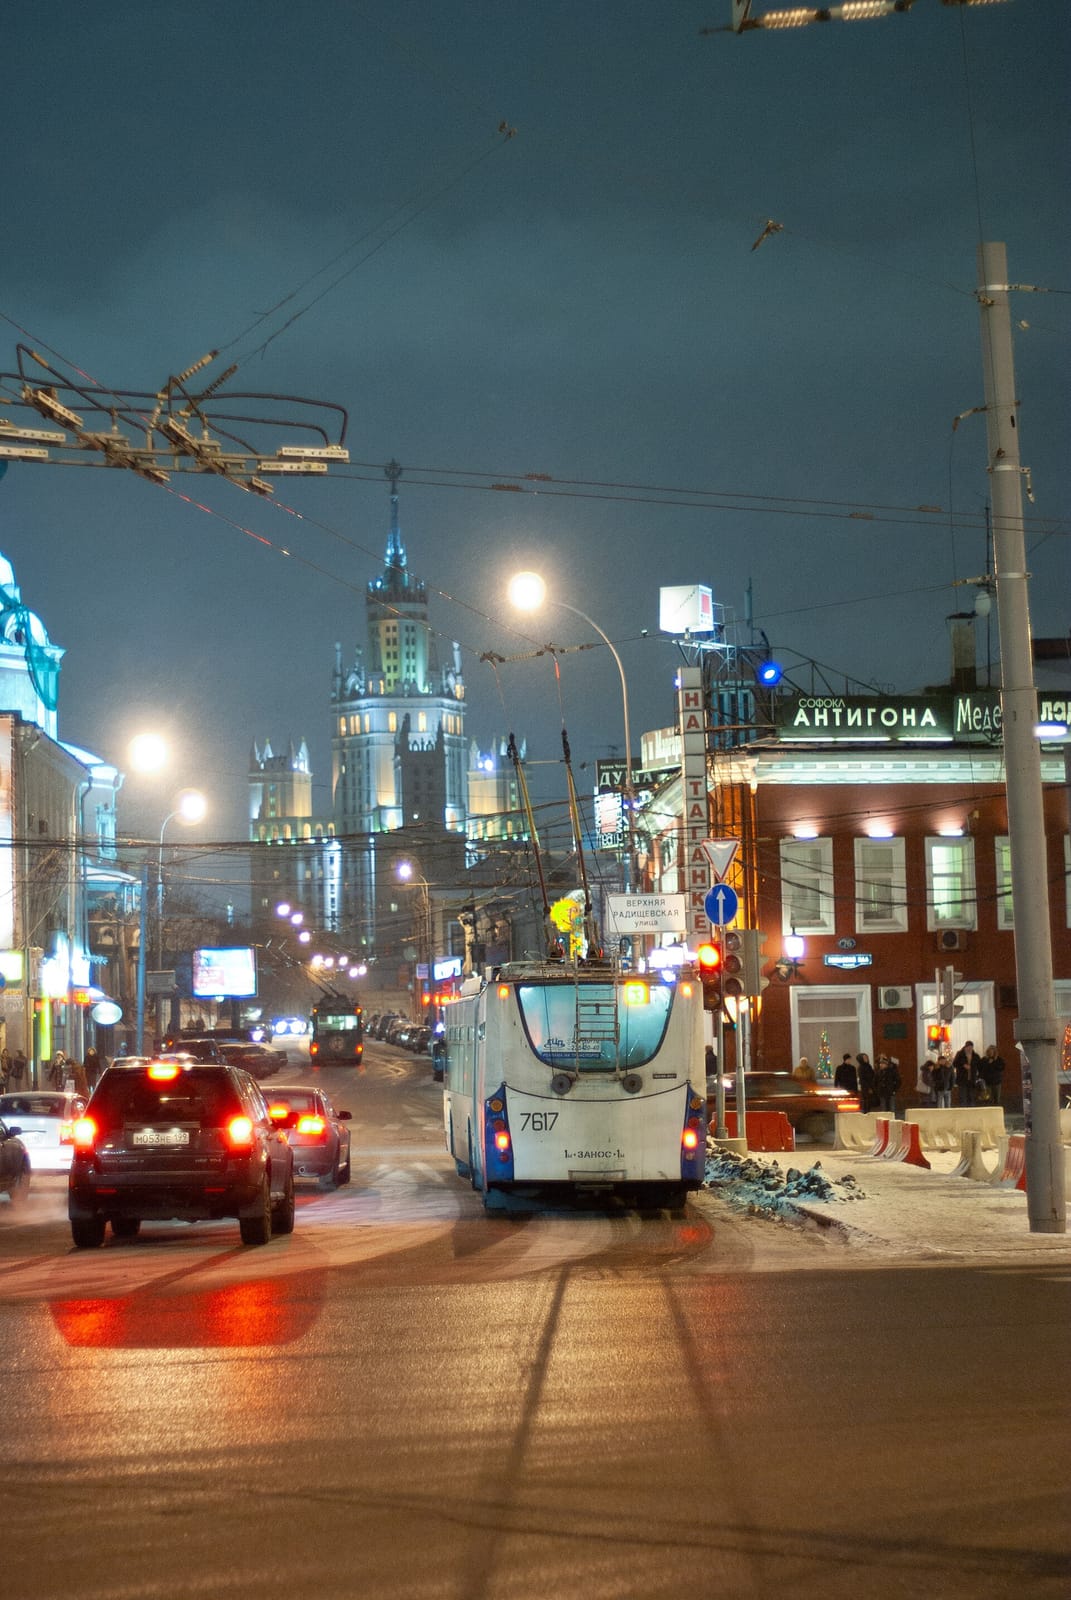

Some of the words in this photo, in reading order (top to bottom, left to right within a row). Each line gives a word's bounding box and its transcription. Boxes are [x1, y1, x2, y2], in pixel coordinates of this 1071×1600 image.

[798, 698, 846, 709] СОФОКЛ
[684, 692, 700, 729] НА
[956, 698, 1002, 732] Меде
[793, 708, 937, 727] АНТИГОНА
[626, 898, 666, 907] ВЕРХНЯЯ
[613, 909, 680, 919] РАДИЩЕВСКАЯ
[634, 920, 659, 928] улица
[520, 1111, 560, 1132] 7617
[577, 1150, 613, 1159] ЗАНОС
